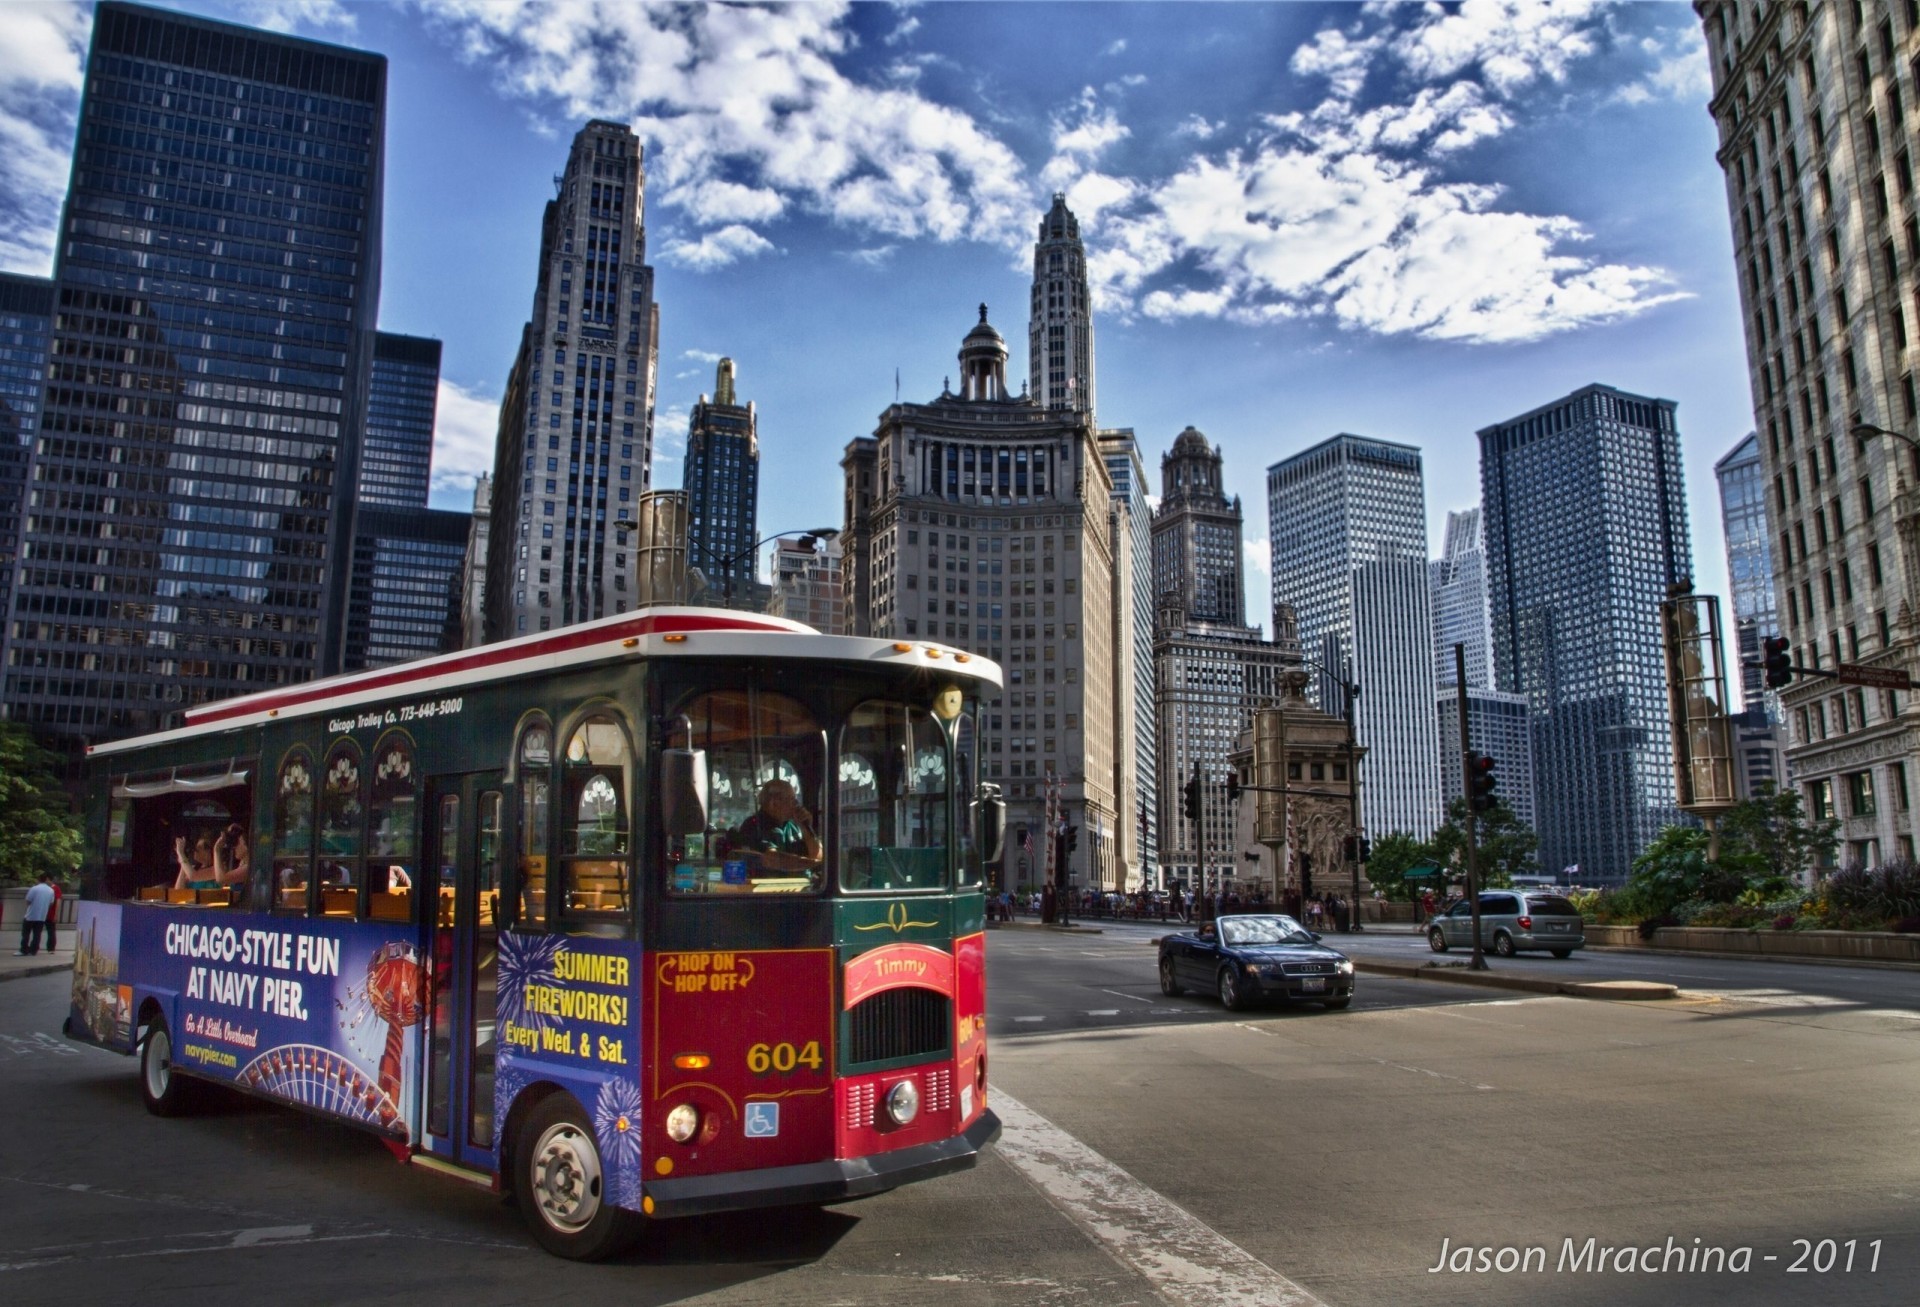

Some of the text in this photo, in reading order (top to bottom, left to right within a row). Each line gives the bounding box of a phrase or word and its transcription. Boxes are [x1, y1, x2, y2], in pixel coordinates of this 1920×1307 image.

[329, 697, 463, 733] Chicago Trolley Co. 773-648-5000
[165, 923, 340, 976] CHICAGO-STYLE FUN
[678, 953, 735, 972] HOP ON
[554, 951, 629, 986] SUMMER
[675, 973, 737, 993] HOP OFF
[874, 958, 927, 977] Timmy
[186, 966, 308, 1021] AT NAVY PIER.
[525, 984, 628, 1026] FIREWORKS!
[185, 1013, 259, 1047] Go A Little Overboard
[506, 1020, 627, 1064] Every Wed. & Sat.
[185, 1044, 237, 1069] navypier.com
[747, 1041, 822, 1073] 604
